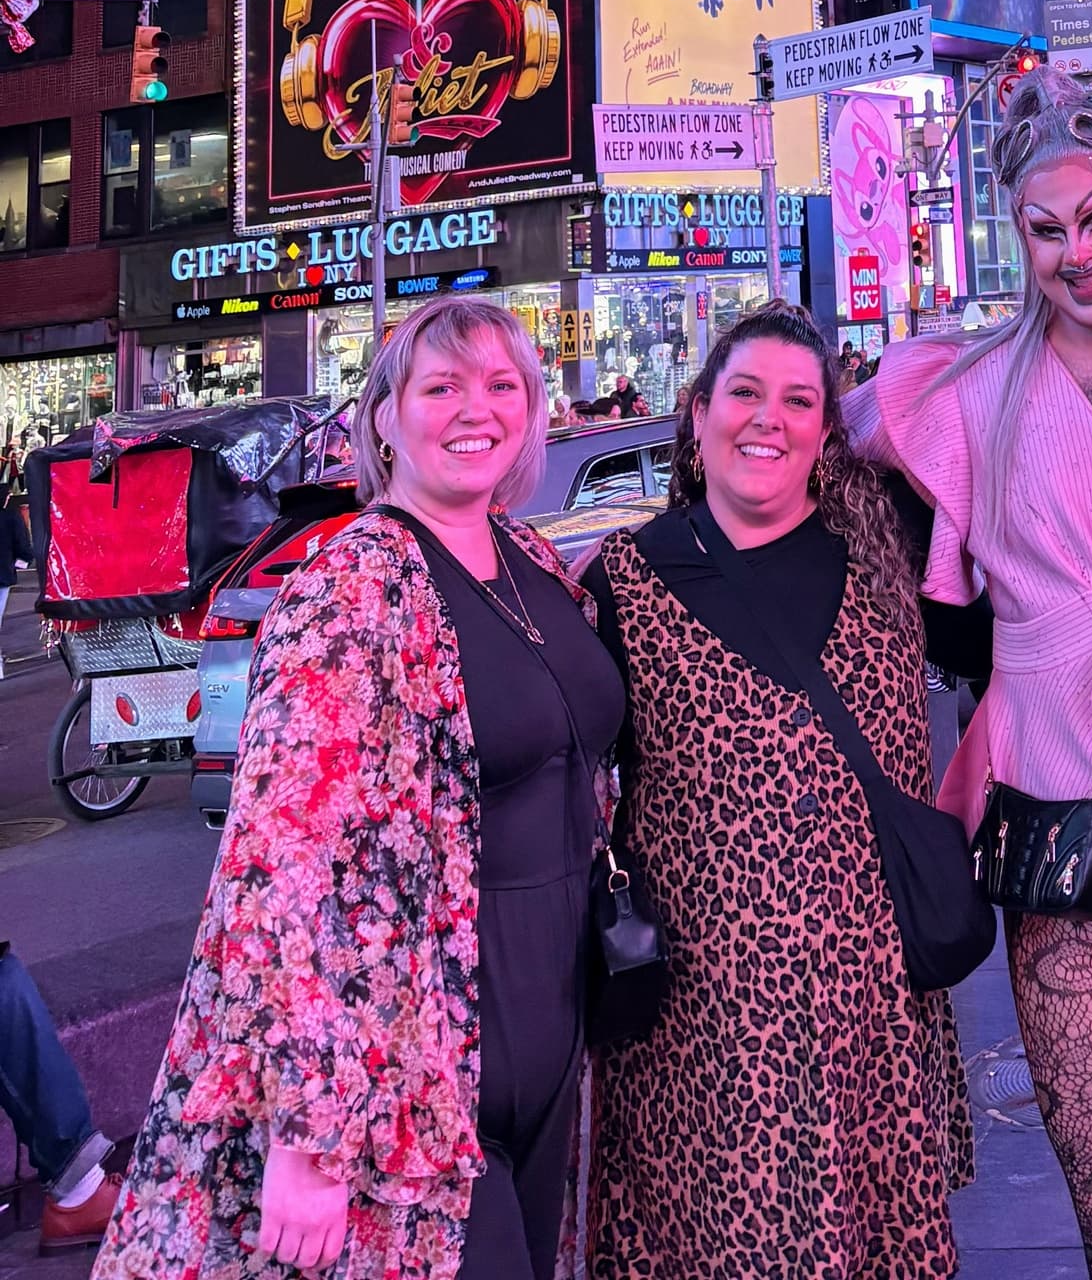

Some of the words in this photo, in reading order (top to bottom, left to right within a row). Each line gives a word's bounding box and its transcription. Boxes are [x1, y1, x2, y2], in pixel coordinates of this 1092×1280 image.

[632, 17, 651, 39] Run
[1051, 19, 1090, 32] Times
[784, 34, 856, 63] PEDESTRIAN
[860, 24, 890, 49] FLOW
[894, 16, 924, 41] ZONE
[646, 48, 681, 73] AGAIN!
[786, 67, 814, 89] KEEP
[819, 57, 862, 84] MOVING
[690, 78, 734, 96] BROADWAY
[322, 51, 515, 160] Jliet
[603, 114, 676, 133] PEDESTRIAN
[681, 114, 710, 133] FLOW
[714, 114, 743, 133] ZONE
[604, 141, 634, 161] KEEP
[639, 141, 684, 161] MOVING
[433, 150, 468, 173] COMEDY
[468, 168, 572, 189] AndJulietBroadway.com
[268, 202, 302, 216] Stephen
[301, 196, 342, 211] Sondheim
[604, 193, 679, 227] GIFTS
[699, 194, 805, 227] LUGGGE
[688, 228, 695, 247] I
[709, 228, 731, 247] NY
[171, 236, 279, 281] GIFTS
[618, 255, 641, 269] Apple
[648, 251, 680, 267] Nikon
[685, 250, 725, 266] Canon
[731, 250, 767, 263] SONY
[779, 250, 801, 262] OWER
[297, 267, 307, 287] I
[324, 262, 357, 283] NY
[456, 273, 485, 286] SAMSUNG
[852, 268, 877, 286] MINI
[334, 286, 374, 302] SON
[398, 276, 440, 294] BOWER
[221, 298, 260, 314] Nikon
[270, 290, 322, 310] Canon
[186, 305, 210, 318] Apple
[564, 314, 575, 353] ATM
[583, 312, 592, 352] ATM
